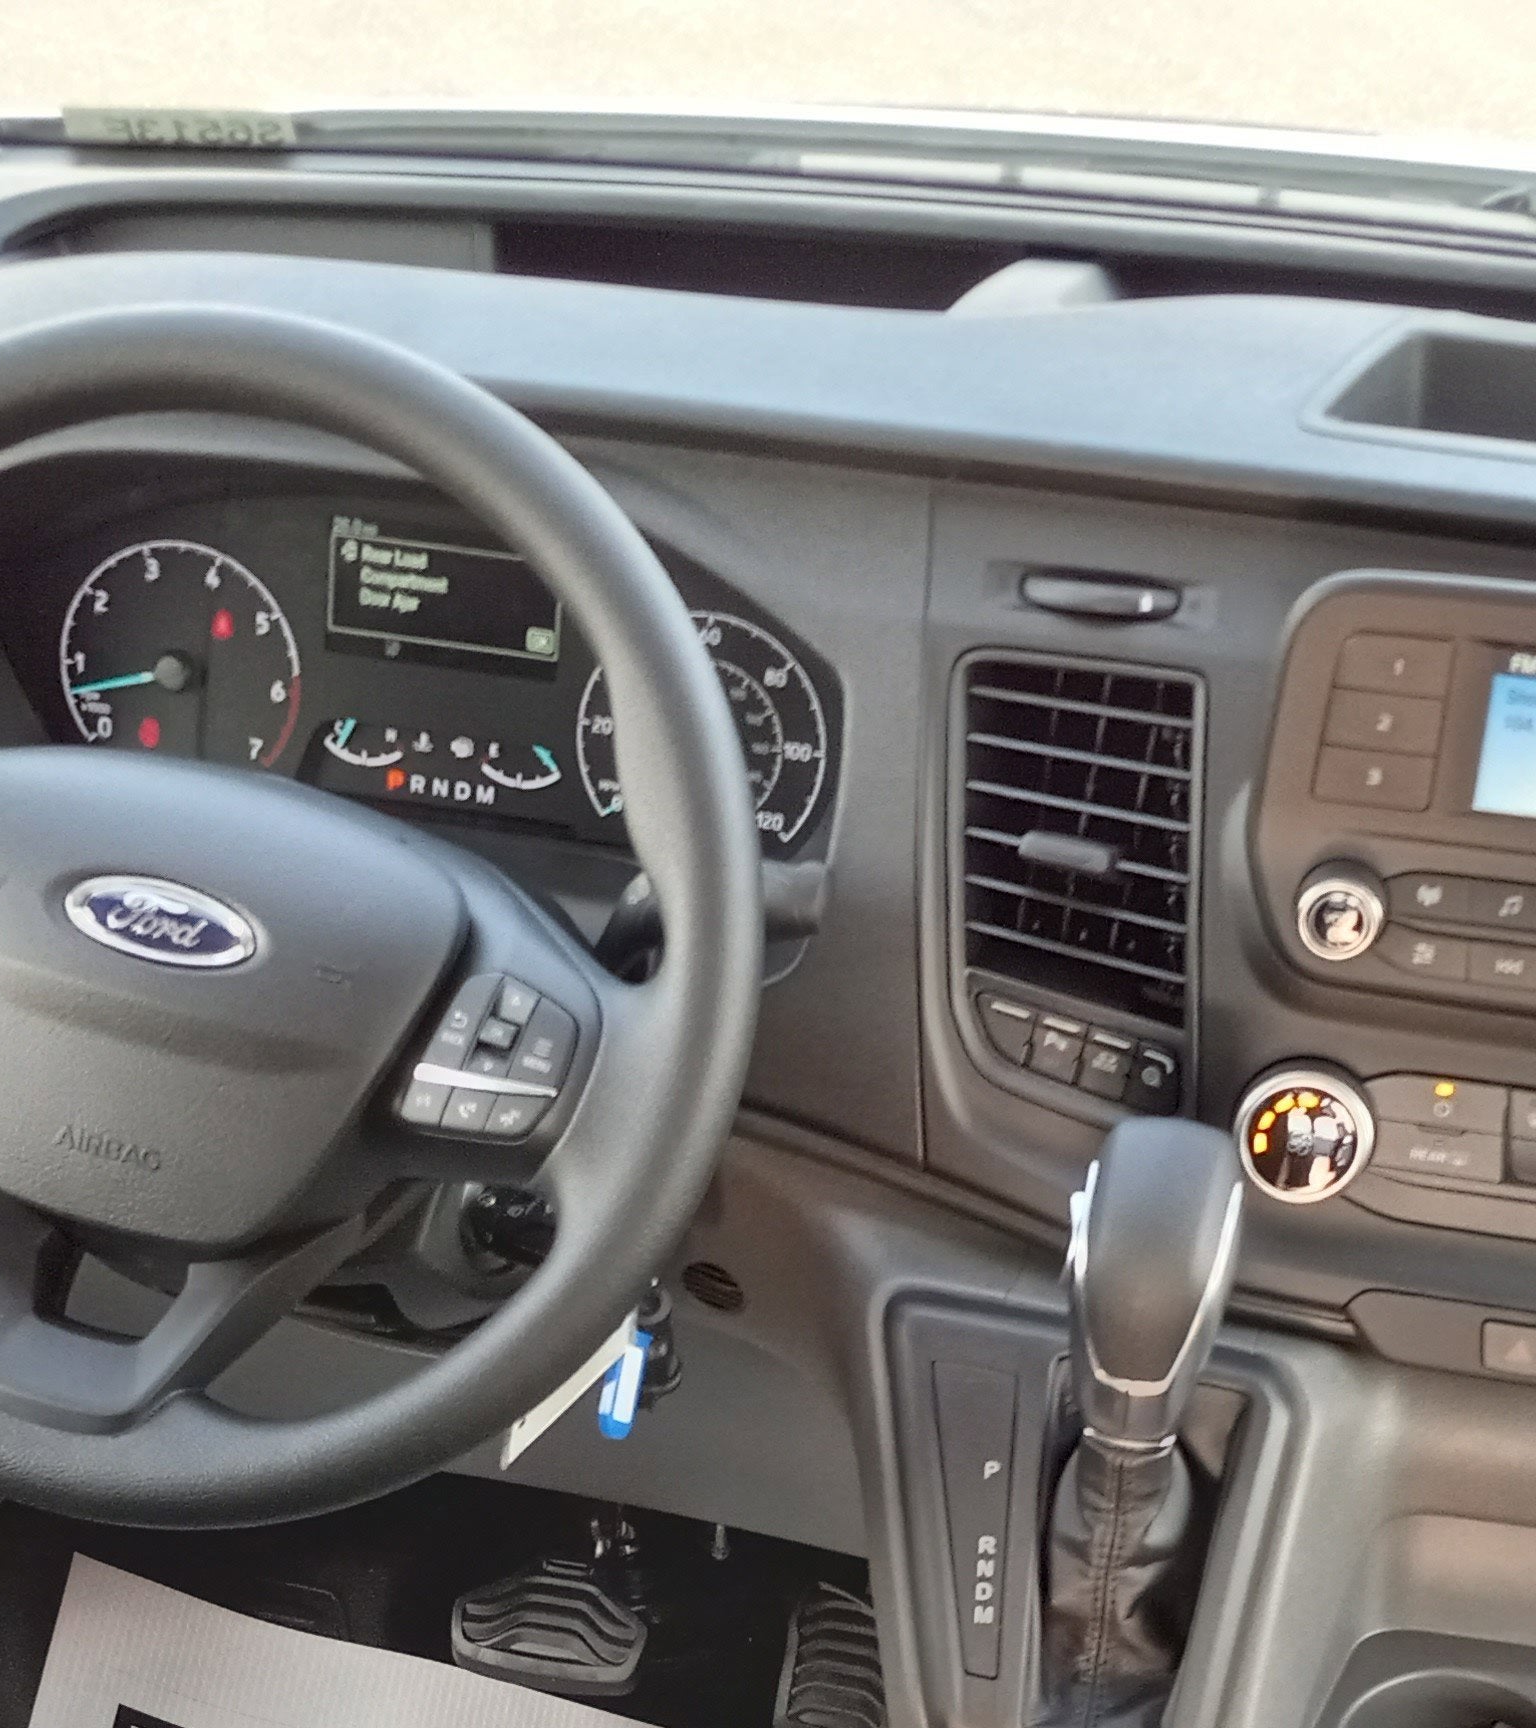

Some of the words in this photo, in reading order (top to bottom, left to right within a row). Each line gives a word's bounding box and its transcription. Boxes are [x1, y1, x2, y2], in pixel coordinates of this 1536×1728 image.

[145, 558, 160, 582] 3
[94, 590, 109, 614] 2
[255, 611, 270, 635] 5
[74, 651, 86, 674] 1
[270, 680, 286, 703] 6
[97, 715, 112, 738] 0
[591, 715, 613, 735] 20
[249, 737, 263, 760] 7
[107, 891, 209, 949] Ford
